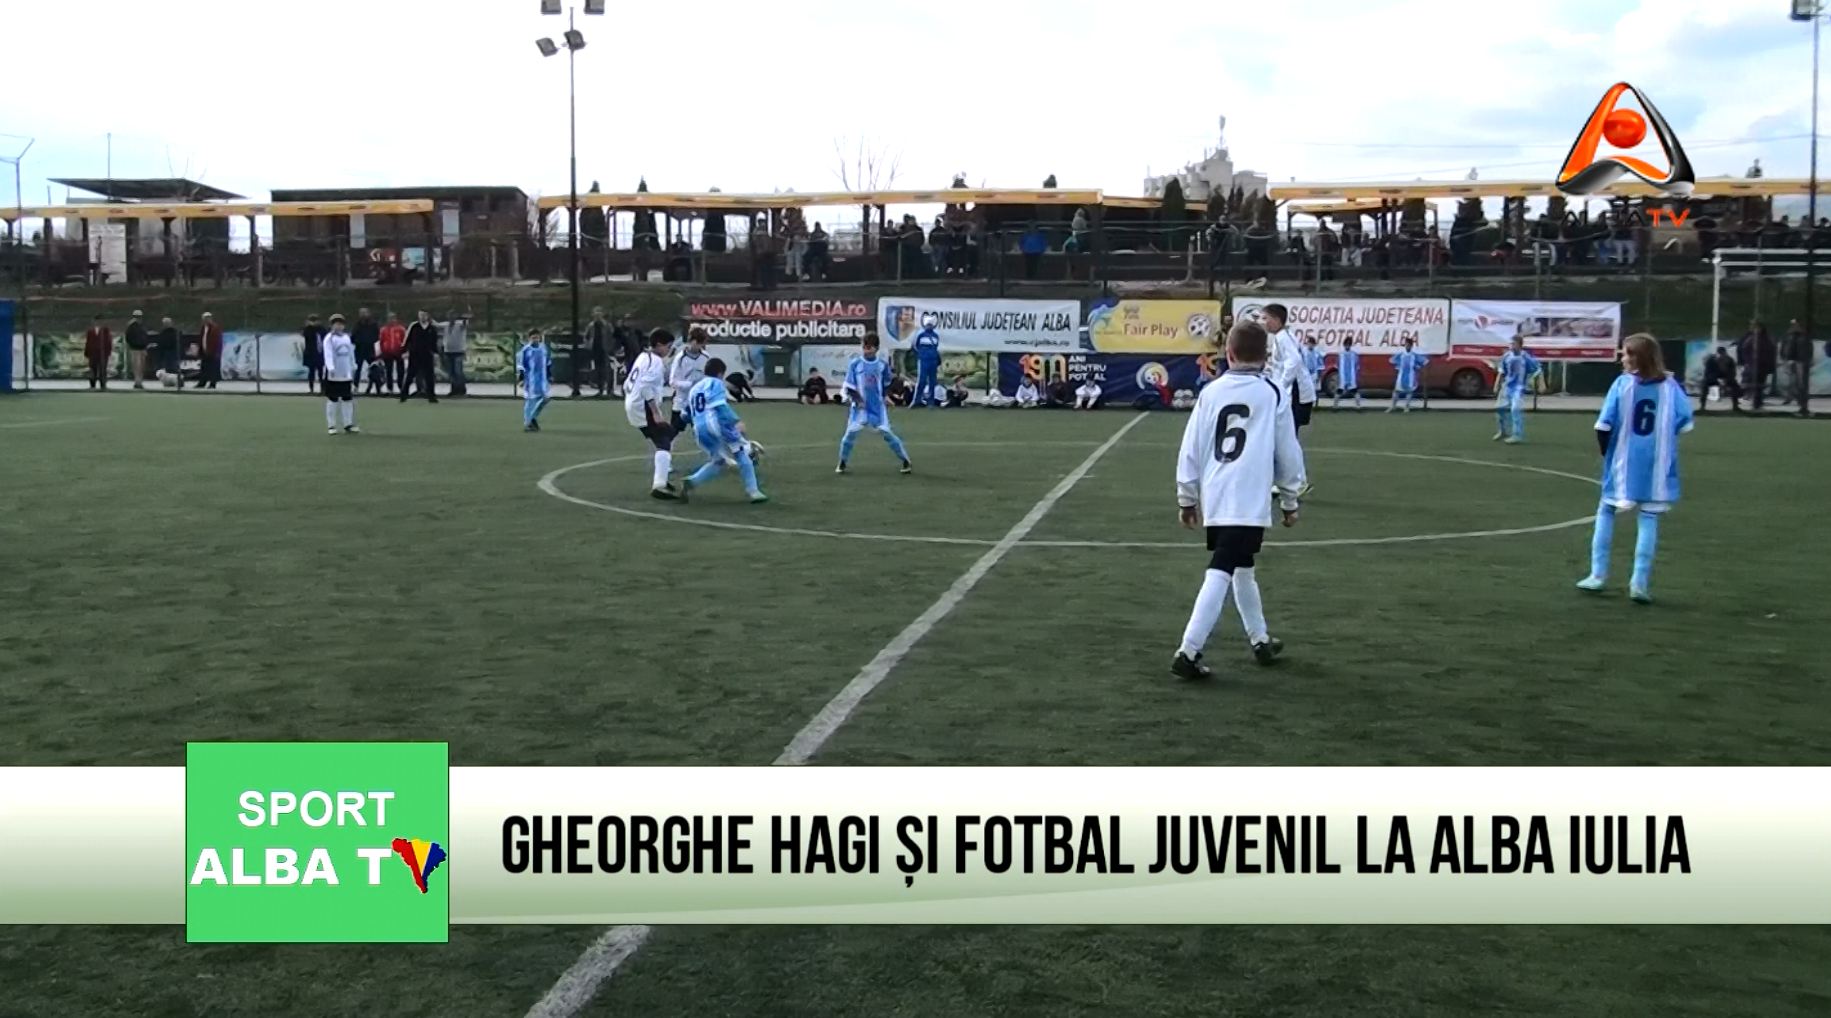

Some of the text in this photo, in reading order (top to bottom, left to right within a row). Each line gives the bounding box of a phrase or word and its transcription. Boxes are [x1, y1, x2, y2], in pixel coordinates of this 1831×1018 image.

[1041, 312, 1071, 331] ALBA
[1288, 306, 1354, 325] SOCIATIA
[1124, 323, 1179, 339] Fair Play
[1068, 355, 1087, 363] ANI
[1068, 364, 1107, 372] PENTRU
[1068, 373, 1106, 381] FOTAL
[691, 392, 706, 417] 10
[1633, 398, 1656, 437] 6
[1214, 404, 1250, 463] 6
